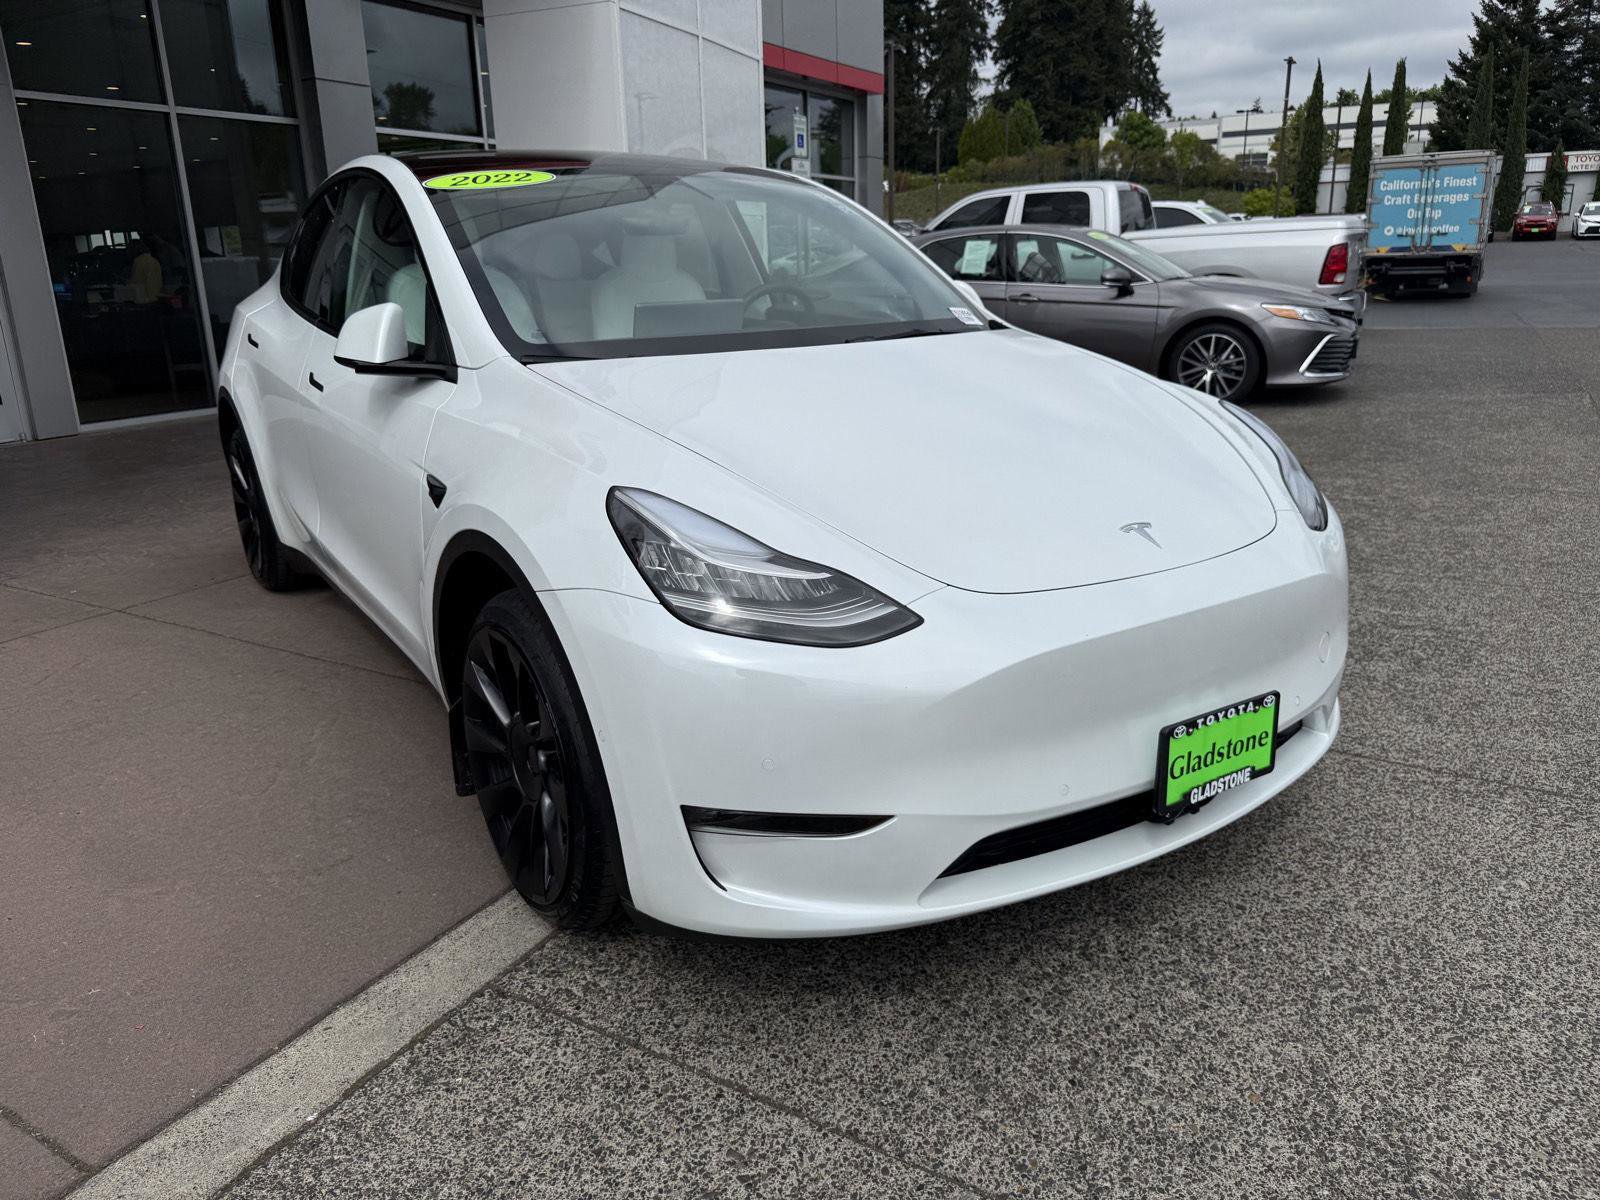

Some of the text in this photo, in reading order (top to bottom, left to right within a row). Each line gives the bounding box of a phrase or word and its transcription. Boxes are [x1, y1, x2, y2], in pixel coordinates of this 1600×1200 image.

[451, 173, 532, 187] 2022
[1380, 176, 1477, 191] California's Finest
[1384, 193, 1470, 206] Craft Beverages
[1407, 207, 1442, 219] On Tap
[1196, 702, 1254, 729] TOYOTA
[1169, 730, 1269, 780] Gladstone
[1190, 767, 1252, 804] GLADSTONE
